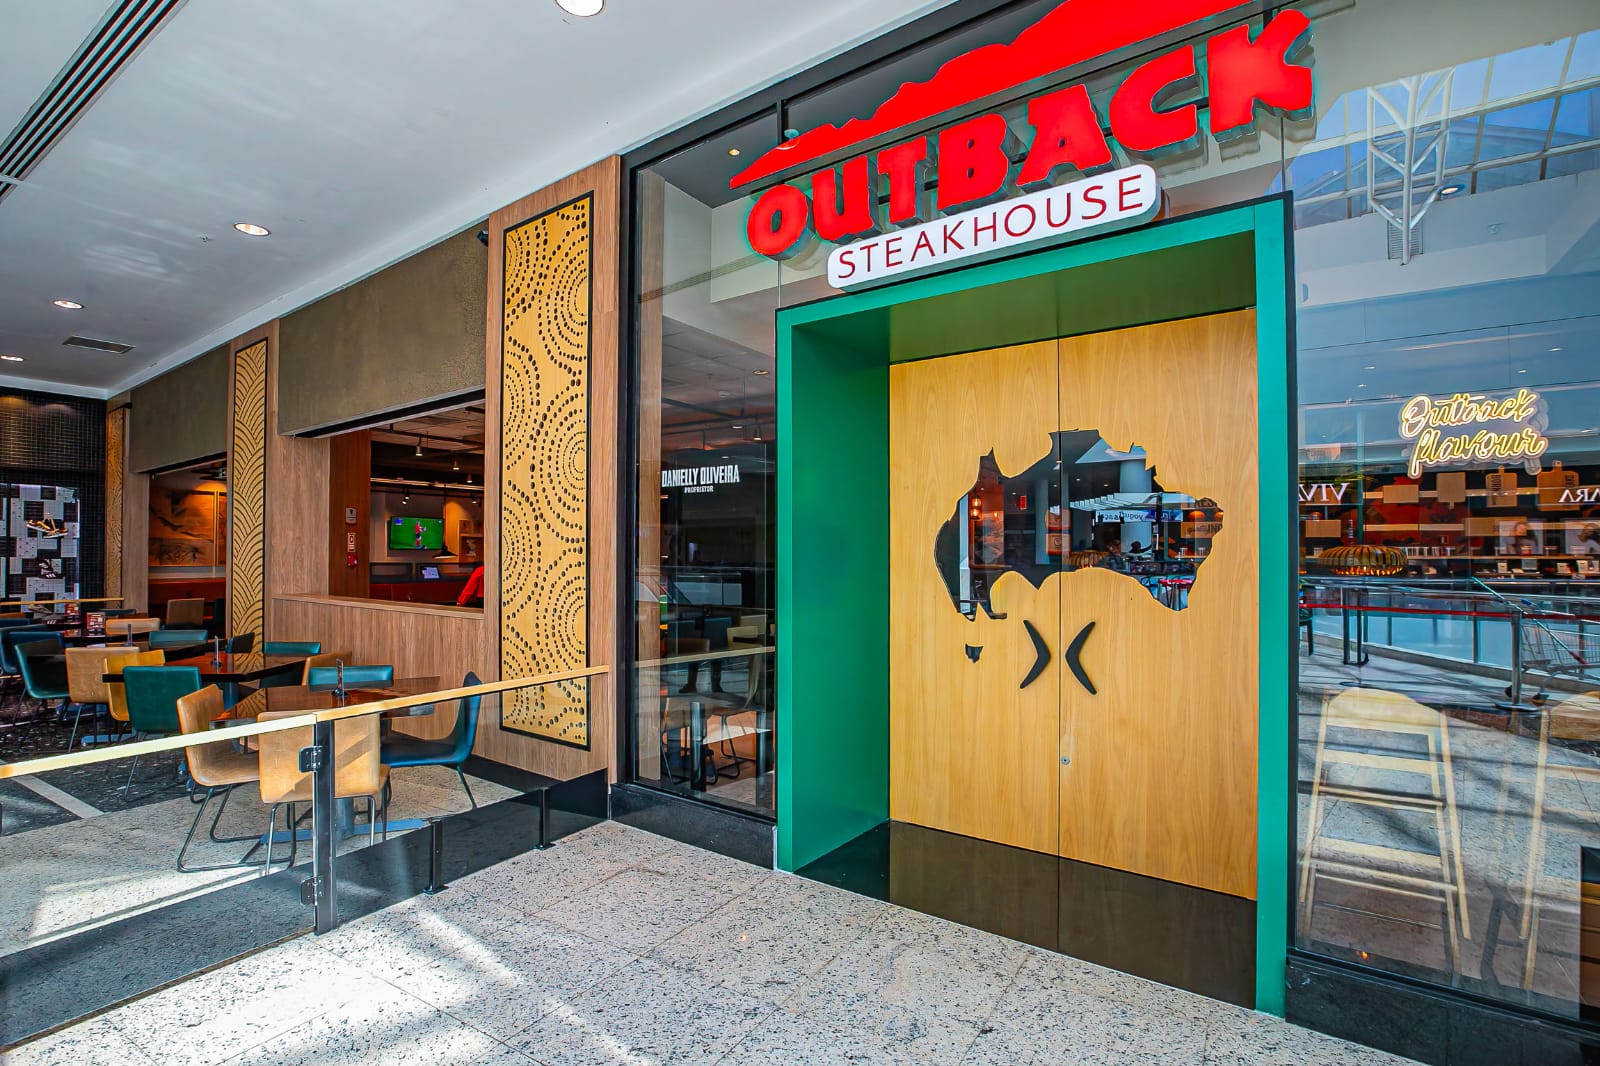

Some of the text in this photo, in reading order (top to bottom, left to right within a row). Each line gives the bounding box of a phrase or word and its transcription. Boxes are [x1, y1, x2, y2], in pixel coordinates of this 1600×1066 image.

[746, 8, 1314, 258] OUTBACK
[837, 173, 1144, 280] STEAKHOUSE
[1401, 388, 1537, 438] Outback
[661, 464, 740, 488] DANIELLY OLIVEIRA
[1411, 427, 1546, 476] flavour
[684, 485, 714, 494] PROPRIETOR
